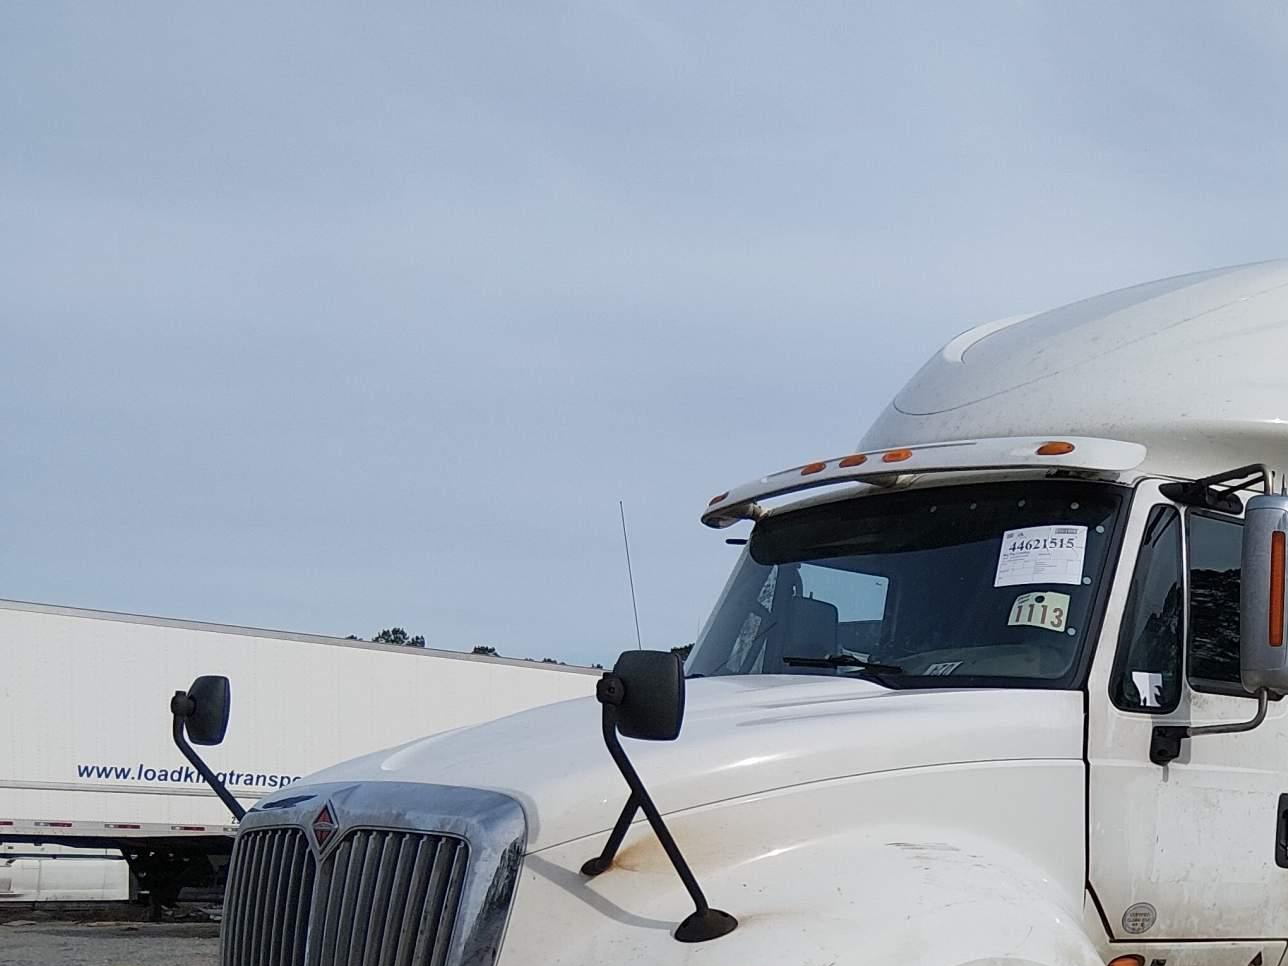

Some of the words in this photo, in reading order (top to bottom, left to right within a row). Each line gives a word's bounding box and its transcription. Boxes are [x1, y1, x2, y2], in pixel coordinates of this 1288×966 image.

[1008, 538, 1075, 552] 44621515
[1015, 603, 1064, 628] 1113
[78, 764, 302, 789] www.loadkigtransp
